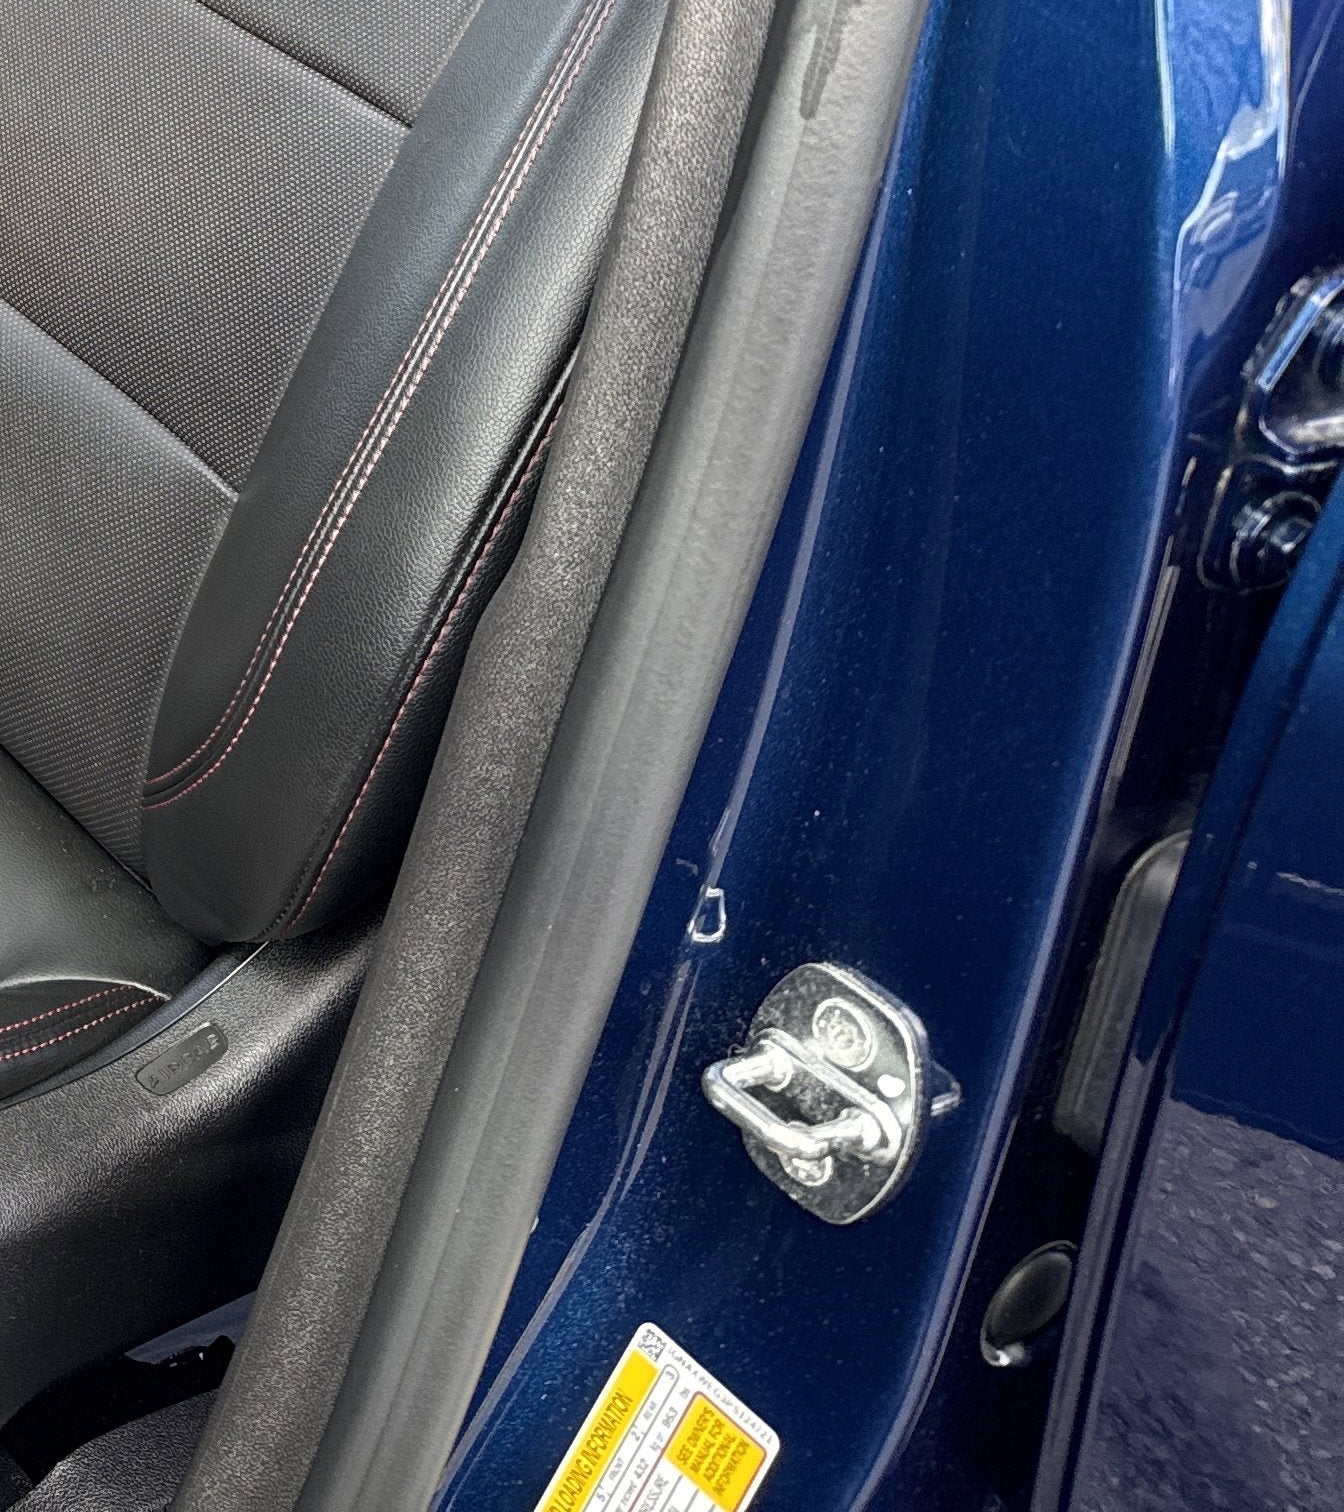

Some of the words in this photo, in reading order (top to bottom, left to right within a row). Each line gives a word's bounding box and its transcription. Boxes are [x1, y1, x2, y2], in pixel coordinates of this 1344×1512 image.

[662, 1406, 678, 1428] 953
[559, 1449, 593, 1511] LOADING
[581, 1388, 633, 1468] INFORMATION
[676, 1444, 693, 1465] SEE
[703, 1433, 737, 1483] ADDITIONAL
